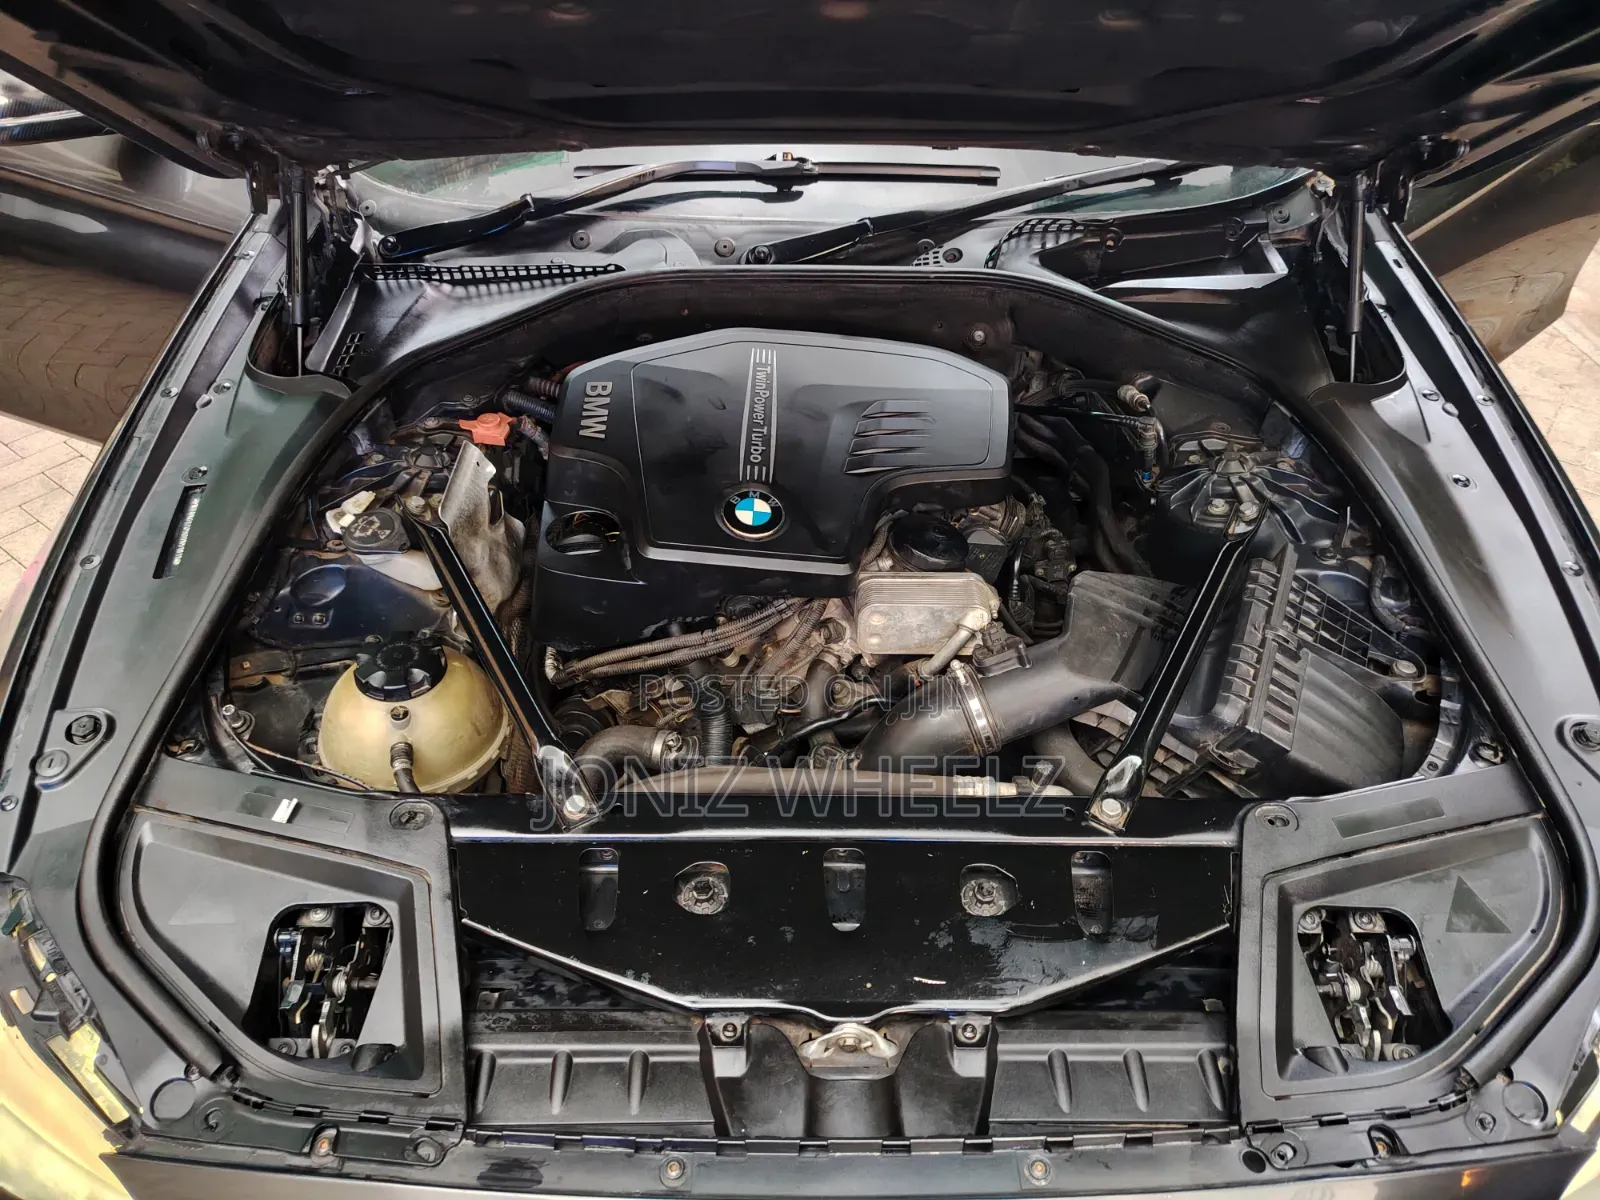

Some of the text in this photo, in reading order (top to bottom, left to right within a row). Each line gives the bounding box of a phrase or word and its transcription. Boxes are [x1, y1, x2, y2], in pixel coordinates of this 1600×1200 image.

[579, 381, 613, 439] BMW
[750, 366, 771, 463] TwinPower Turbo
[729, 491, 779, 507] BMW
